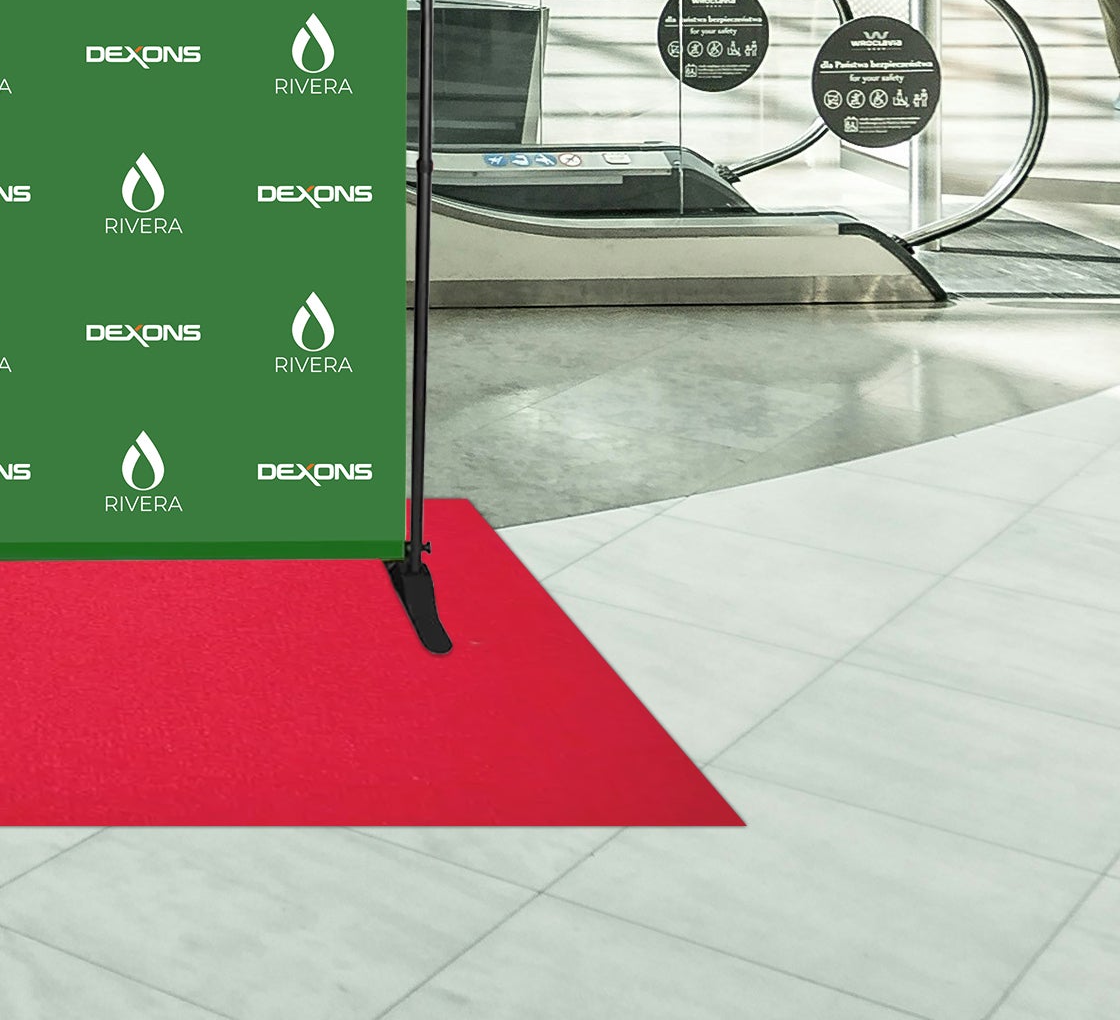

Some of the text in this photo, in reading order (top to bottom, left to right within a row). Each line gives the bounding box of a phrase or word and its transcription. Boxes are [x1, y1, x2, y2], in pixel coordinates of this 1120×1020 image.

[86, 46, 201, 69] DEXONS
[276, 79, 352, 94] RIVERA
[258, 186, 372, 208] DEXONS
[106, 218, 182, 233] RIVERA
[86, 325, 201, 347] DEXONS
[276, 357, 353, 372] RIVERA
[258, 464, 372, 486] DEXONS
[106, 496, 182, 511] RIVERA
